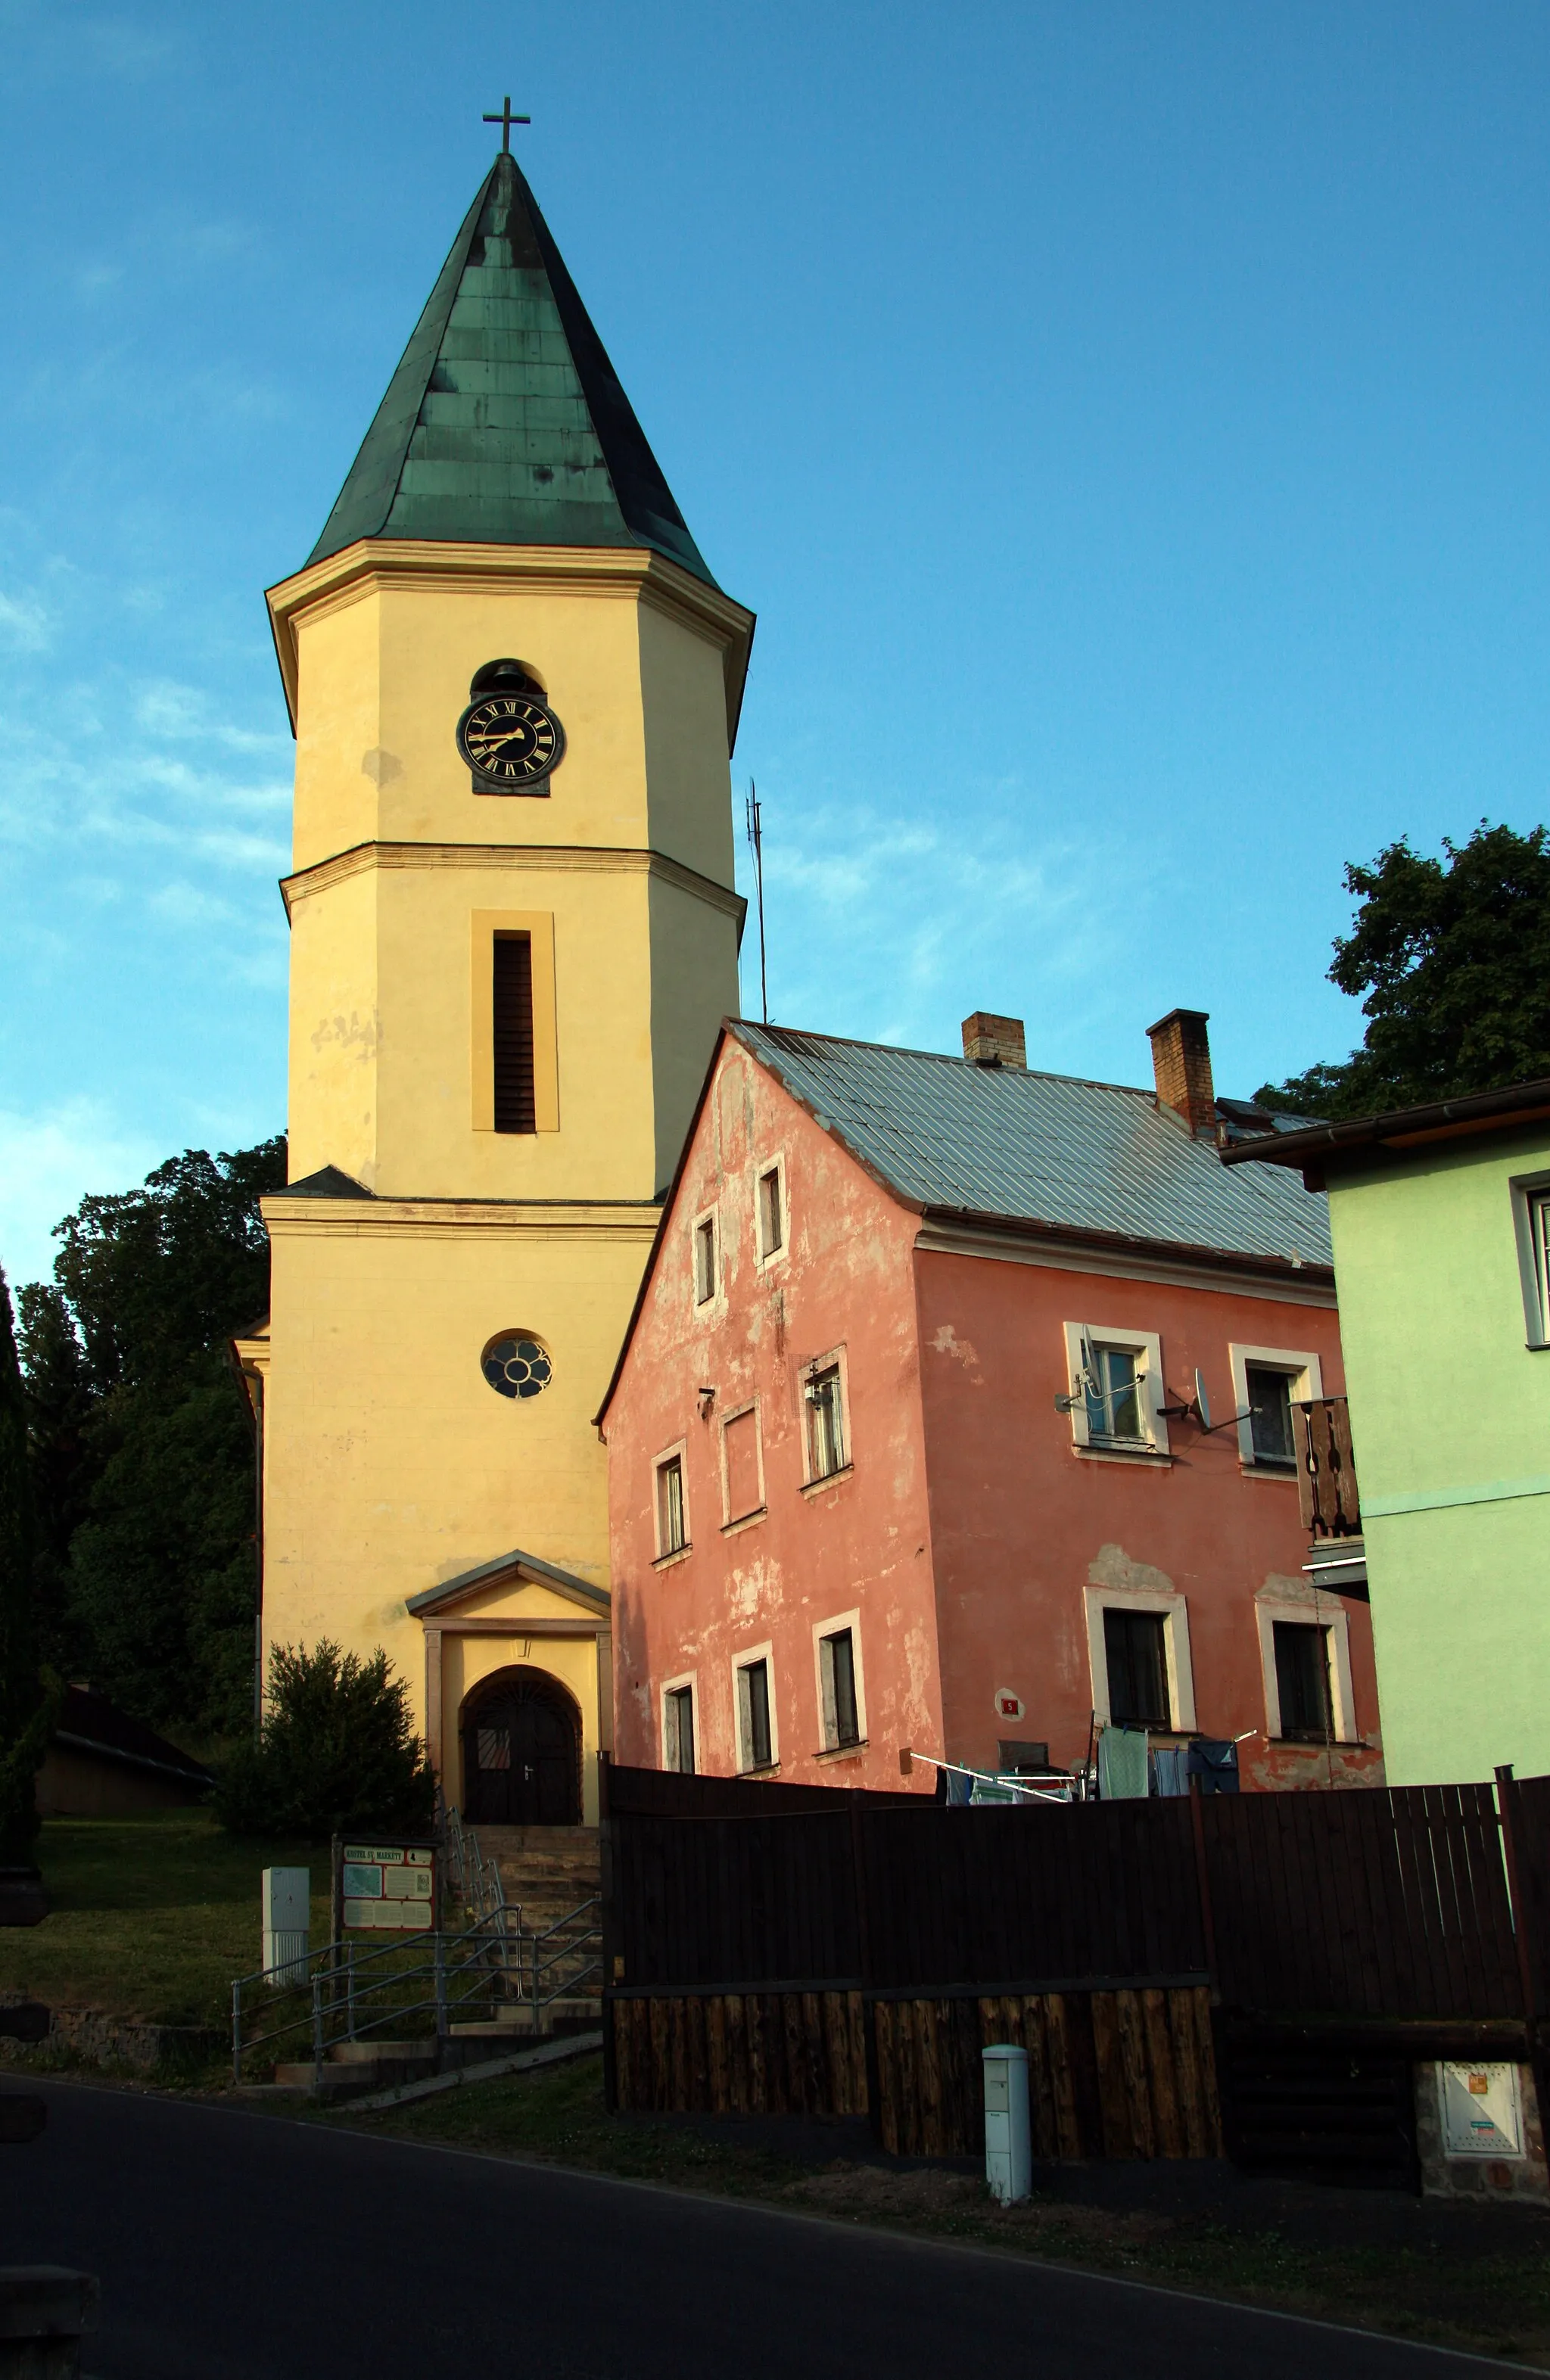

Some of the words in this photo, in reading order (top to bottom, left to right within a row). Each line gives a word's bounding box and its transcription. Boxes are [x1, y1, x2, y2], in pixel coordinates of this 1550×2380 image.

[486, 704, 499, 717] XI
[504, 702, 516, 714] XII
[523, 706, 534, 717] I
[472, 715, 487, 727] X
[534, 719, 548, 730] II
[539, 736, 552, 745] III
[484, 758, 498, 773] VII
[505, 764, 516, 776] VI
[524, 761, 536, 773] V
[1007, 1702, 1013, 1711] 5
